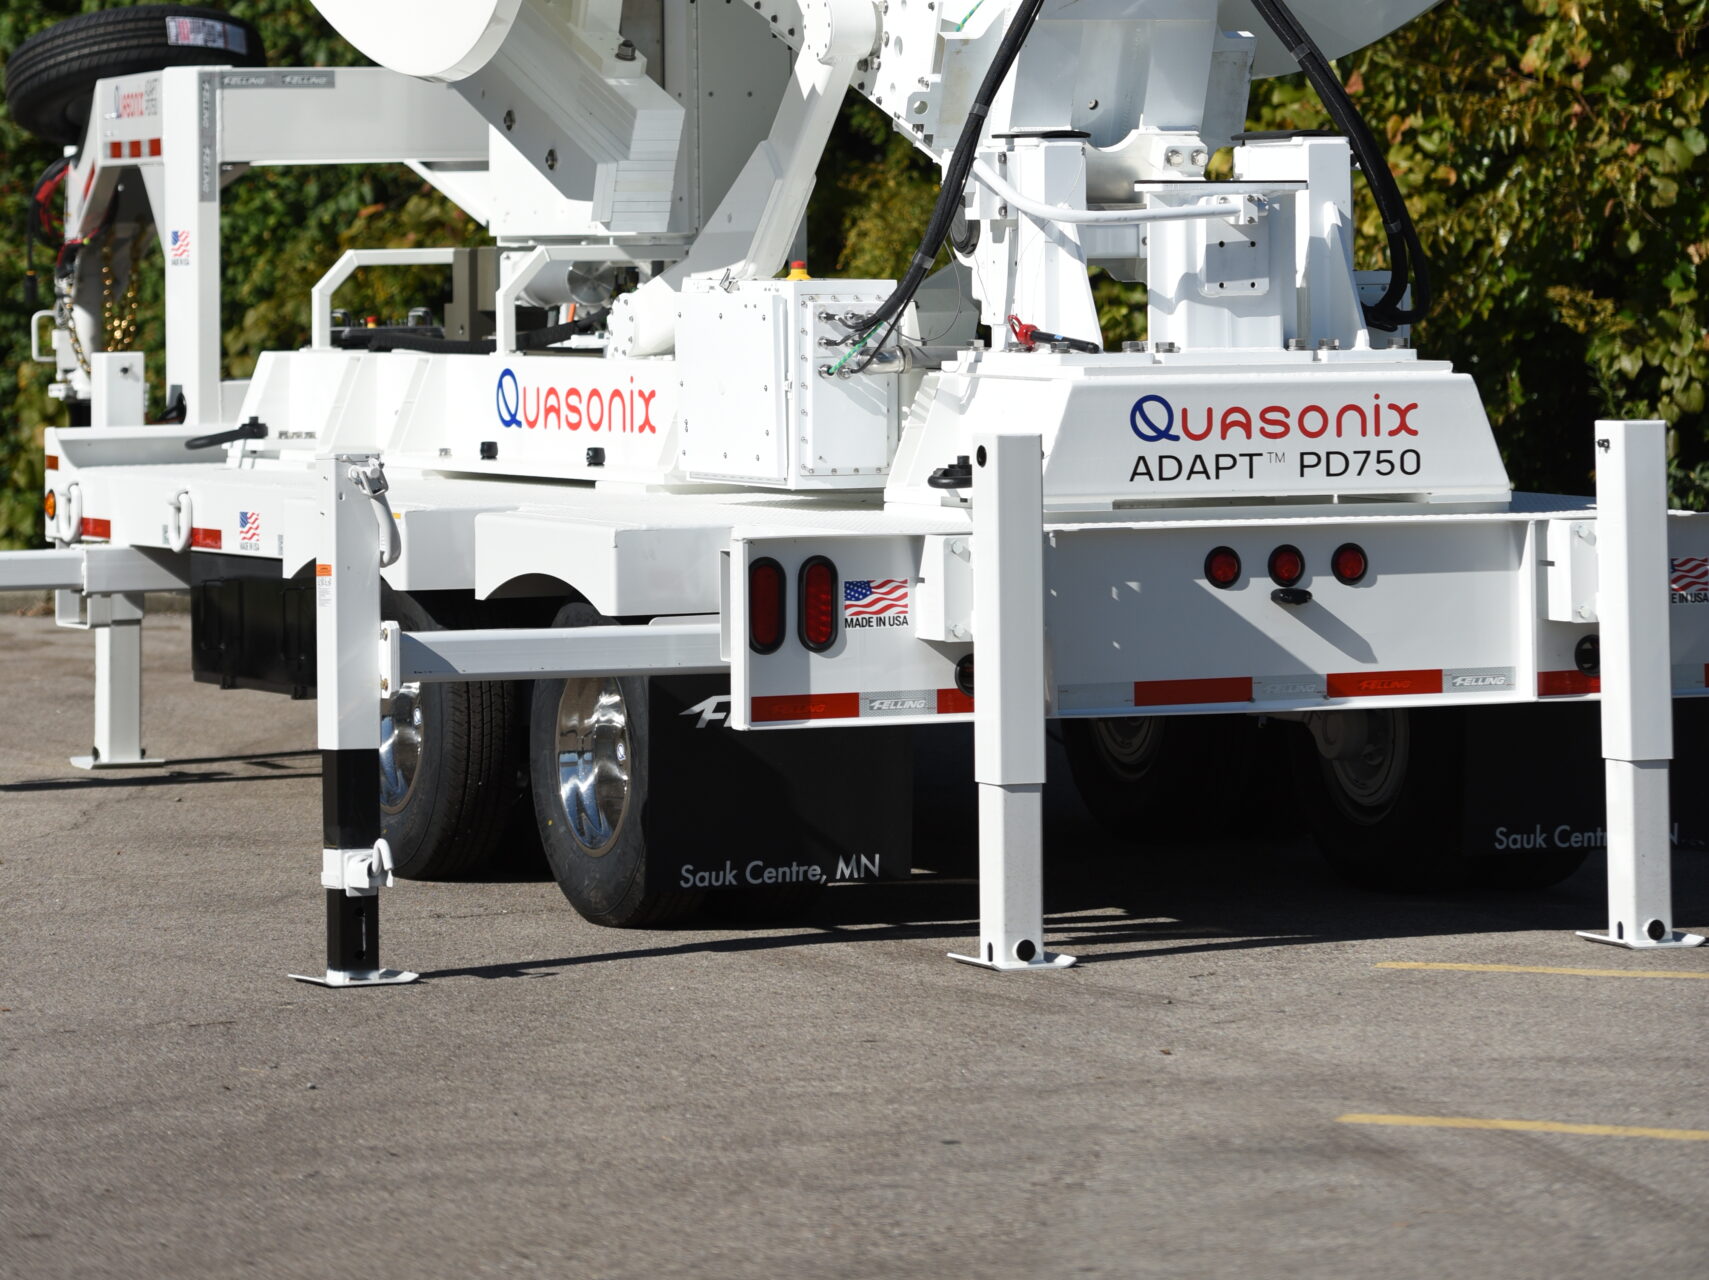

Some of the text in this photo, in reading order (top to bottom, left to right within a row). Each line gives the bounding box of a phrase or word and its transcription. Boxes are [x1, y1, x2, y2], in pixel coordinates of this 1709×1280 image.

[1299, 448, 1421, 478] PD750
[844, 615, 909, 629] MADE IN USA
[1452, 676, 1506, 687] FELLING
[869, 699, 928, 710] FELLING
[1494, 824, 1607, 850] Sauk Centr
[680, 853, 880, 888] Sauk Centre, MN
